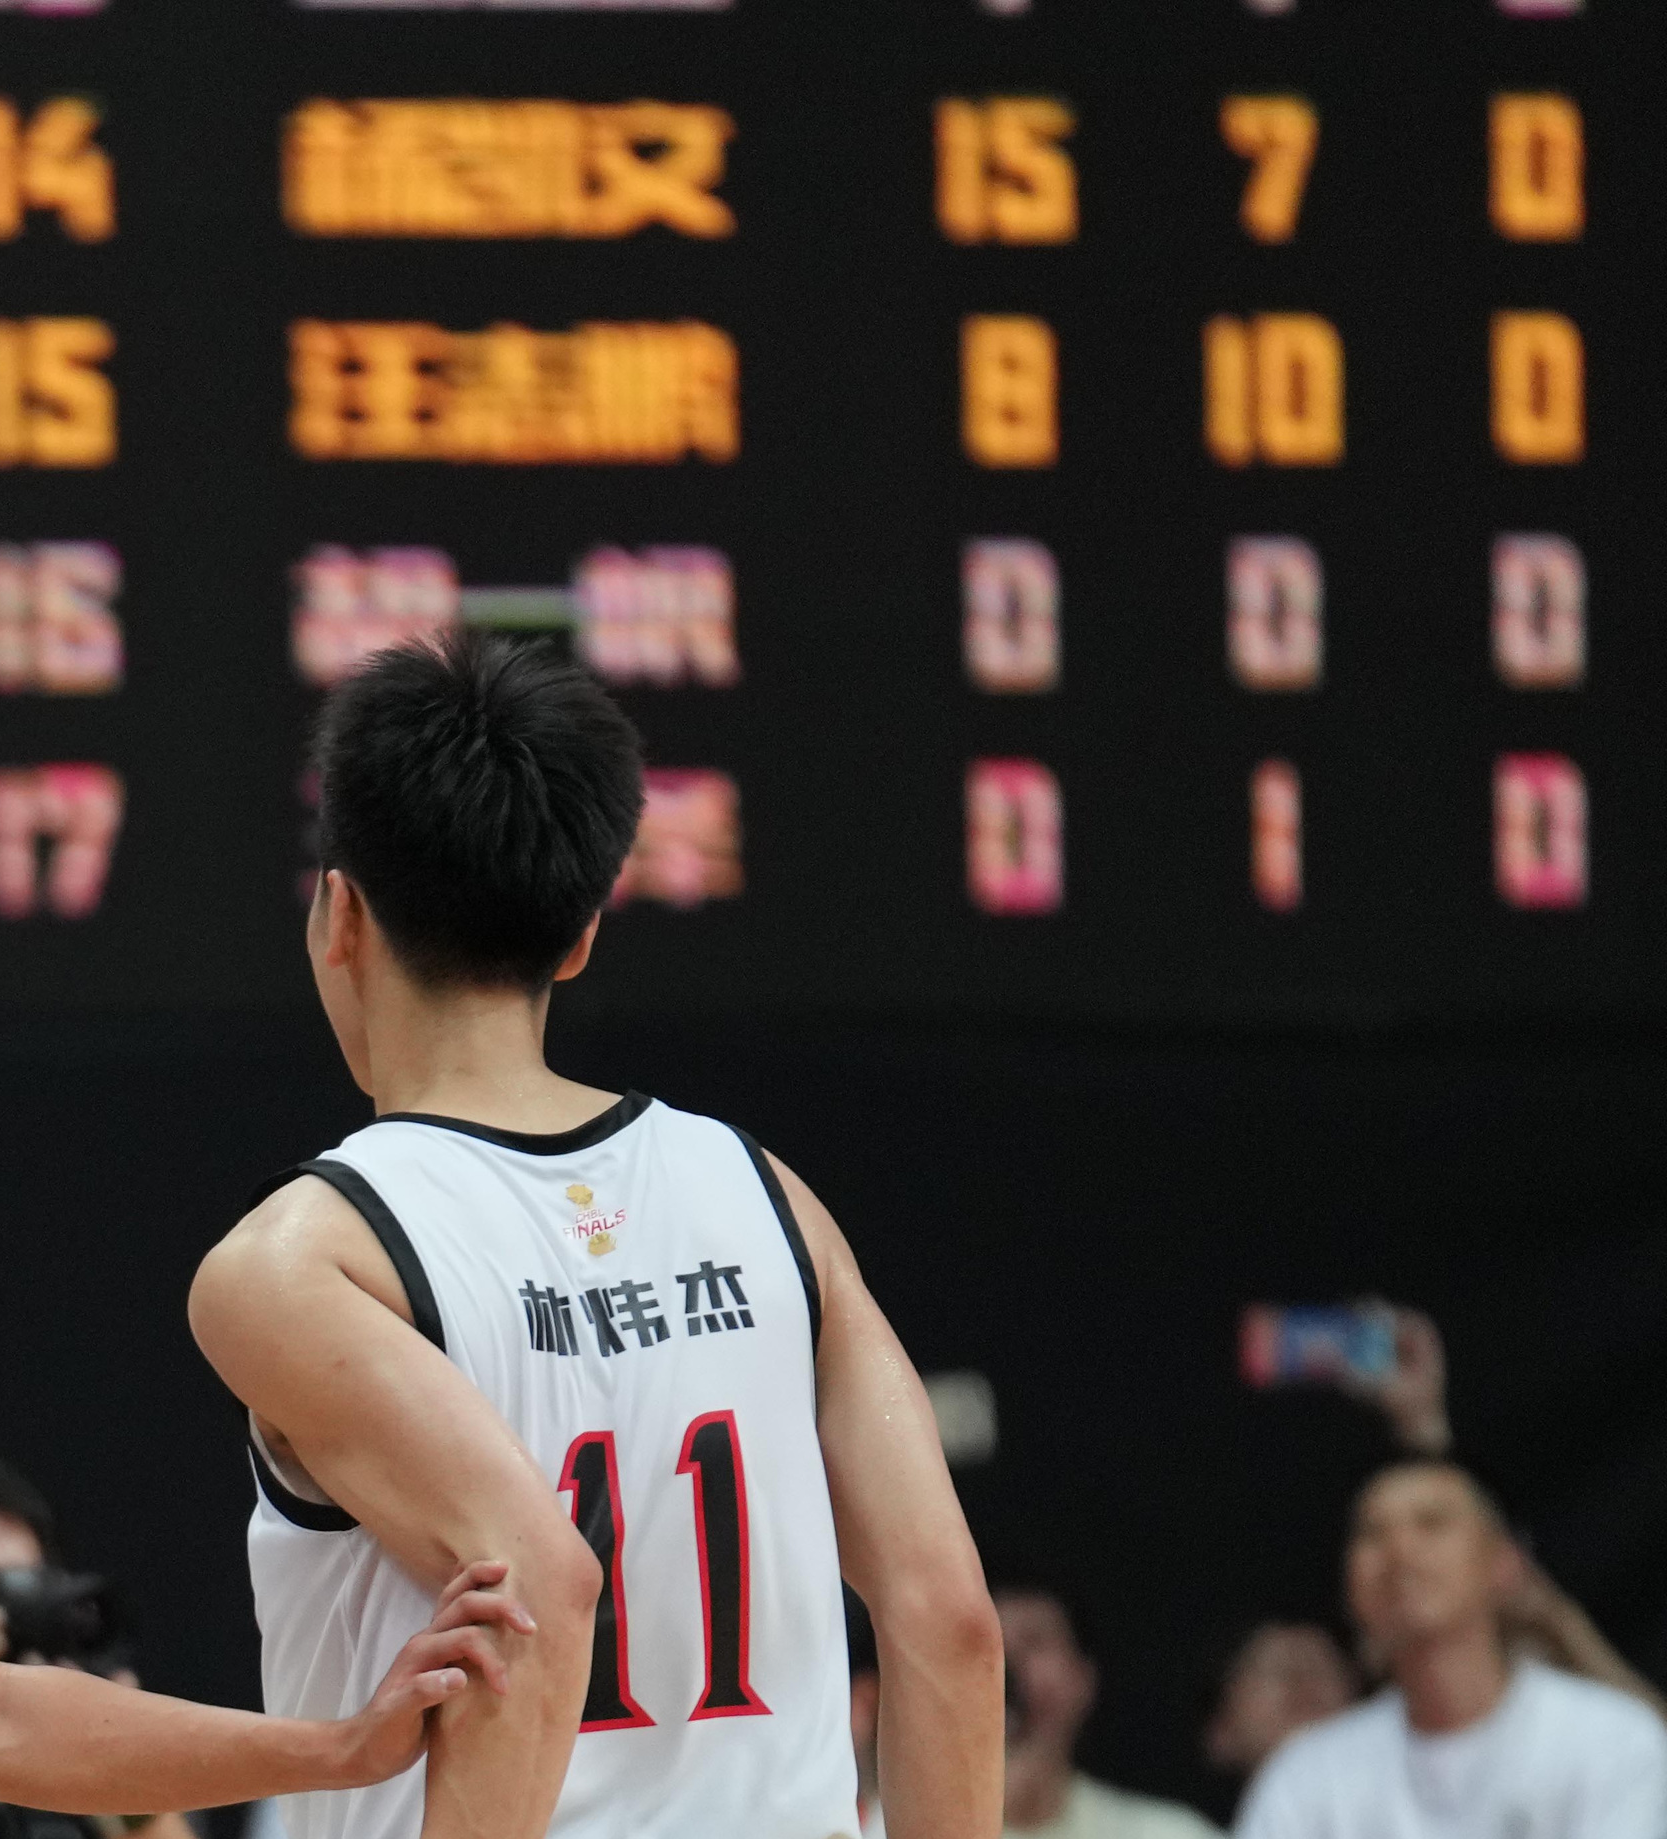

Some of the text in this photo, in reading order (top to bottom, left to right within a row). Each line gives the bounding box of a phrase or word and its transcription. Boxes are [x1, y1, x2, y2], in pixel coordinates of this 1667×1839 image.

[936, 99, 1079, 244] 15
[1221, 97, 1318, 242] 7
[1489, 95, 1585, 241] 0
[962, 315, 1059, 467] 8
[1204, 313, 1344, 467] 10
[1490, 311, 1585, 463] 0
[964, 541, 1059, 689] 0
[1228, 539, 1322, 687] 0
[1494, 537, 1584, 684] 0
[967, 755, 1587, 911] 0 1 0
[563, 1208, 626, 1239] FINALS
[557, 1408, 773, 1733] 11
